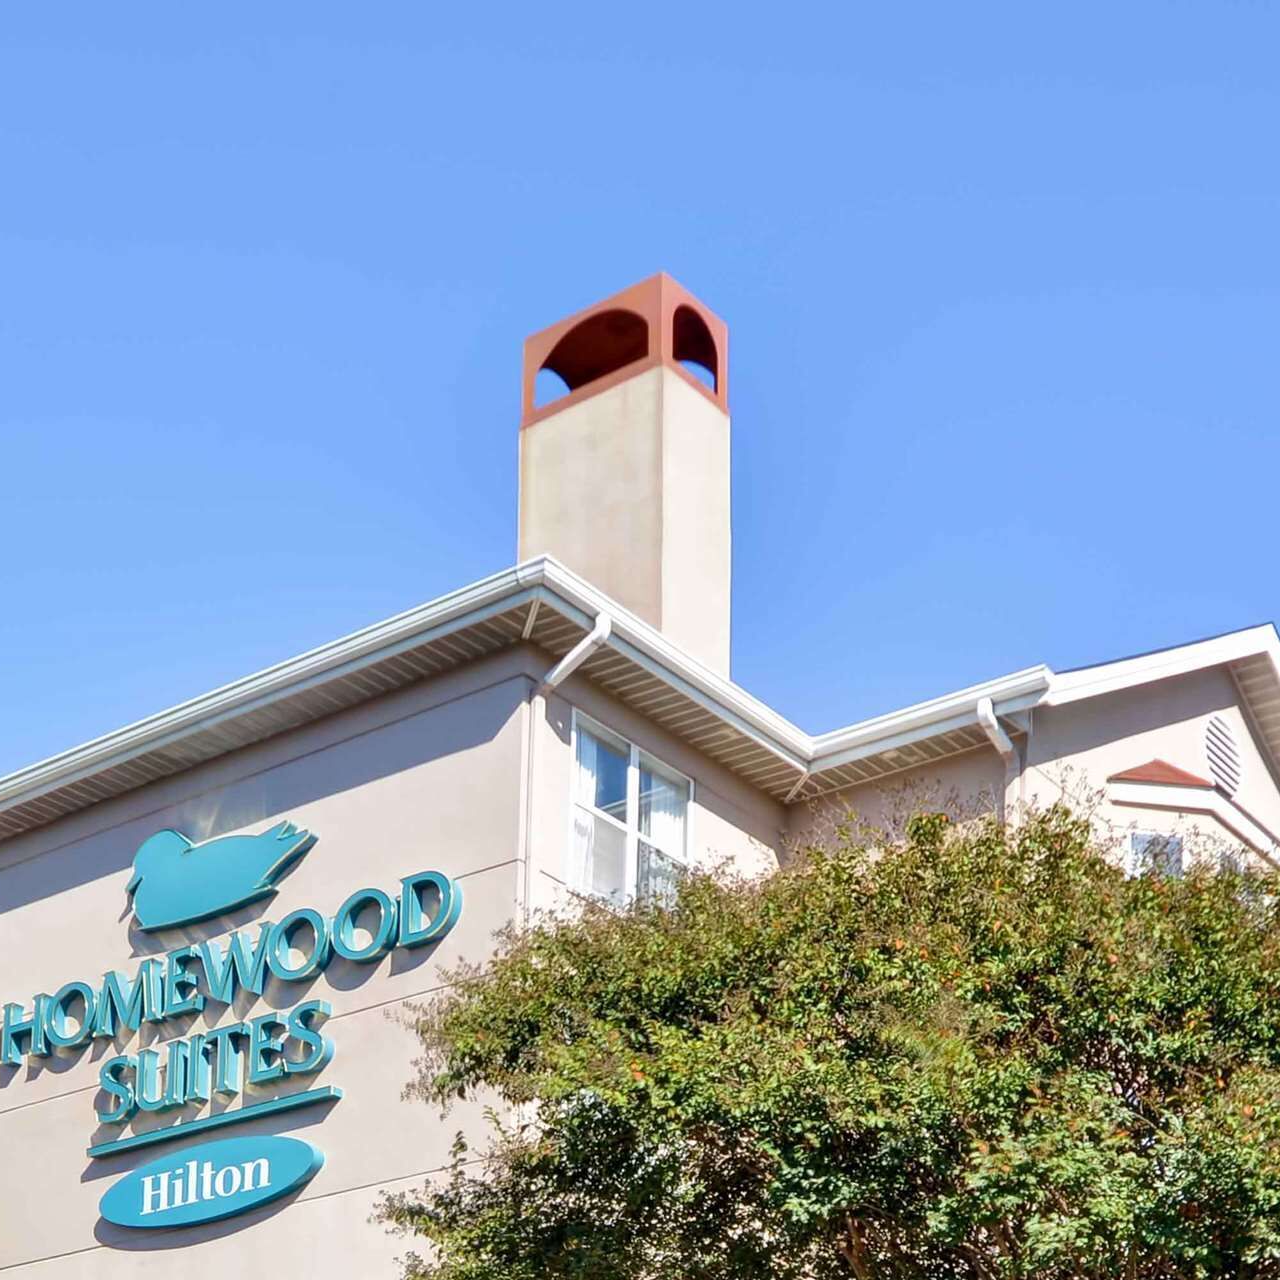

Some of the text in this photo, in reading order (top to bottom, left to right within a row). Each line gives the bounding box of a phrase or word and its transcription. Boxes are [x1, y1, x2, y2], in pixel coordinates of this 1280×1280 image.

[0, 870, 463, 1067] HOMEWOOD
[96, 999, 336, 1125] SUITES
[139, 1155, 272, 1217] Hilton
